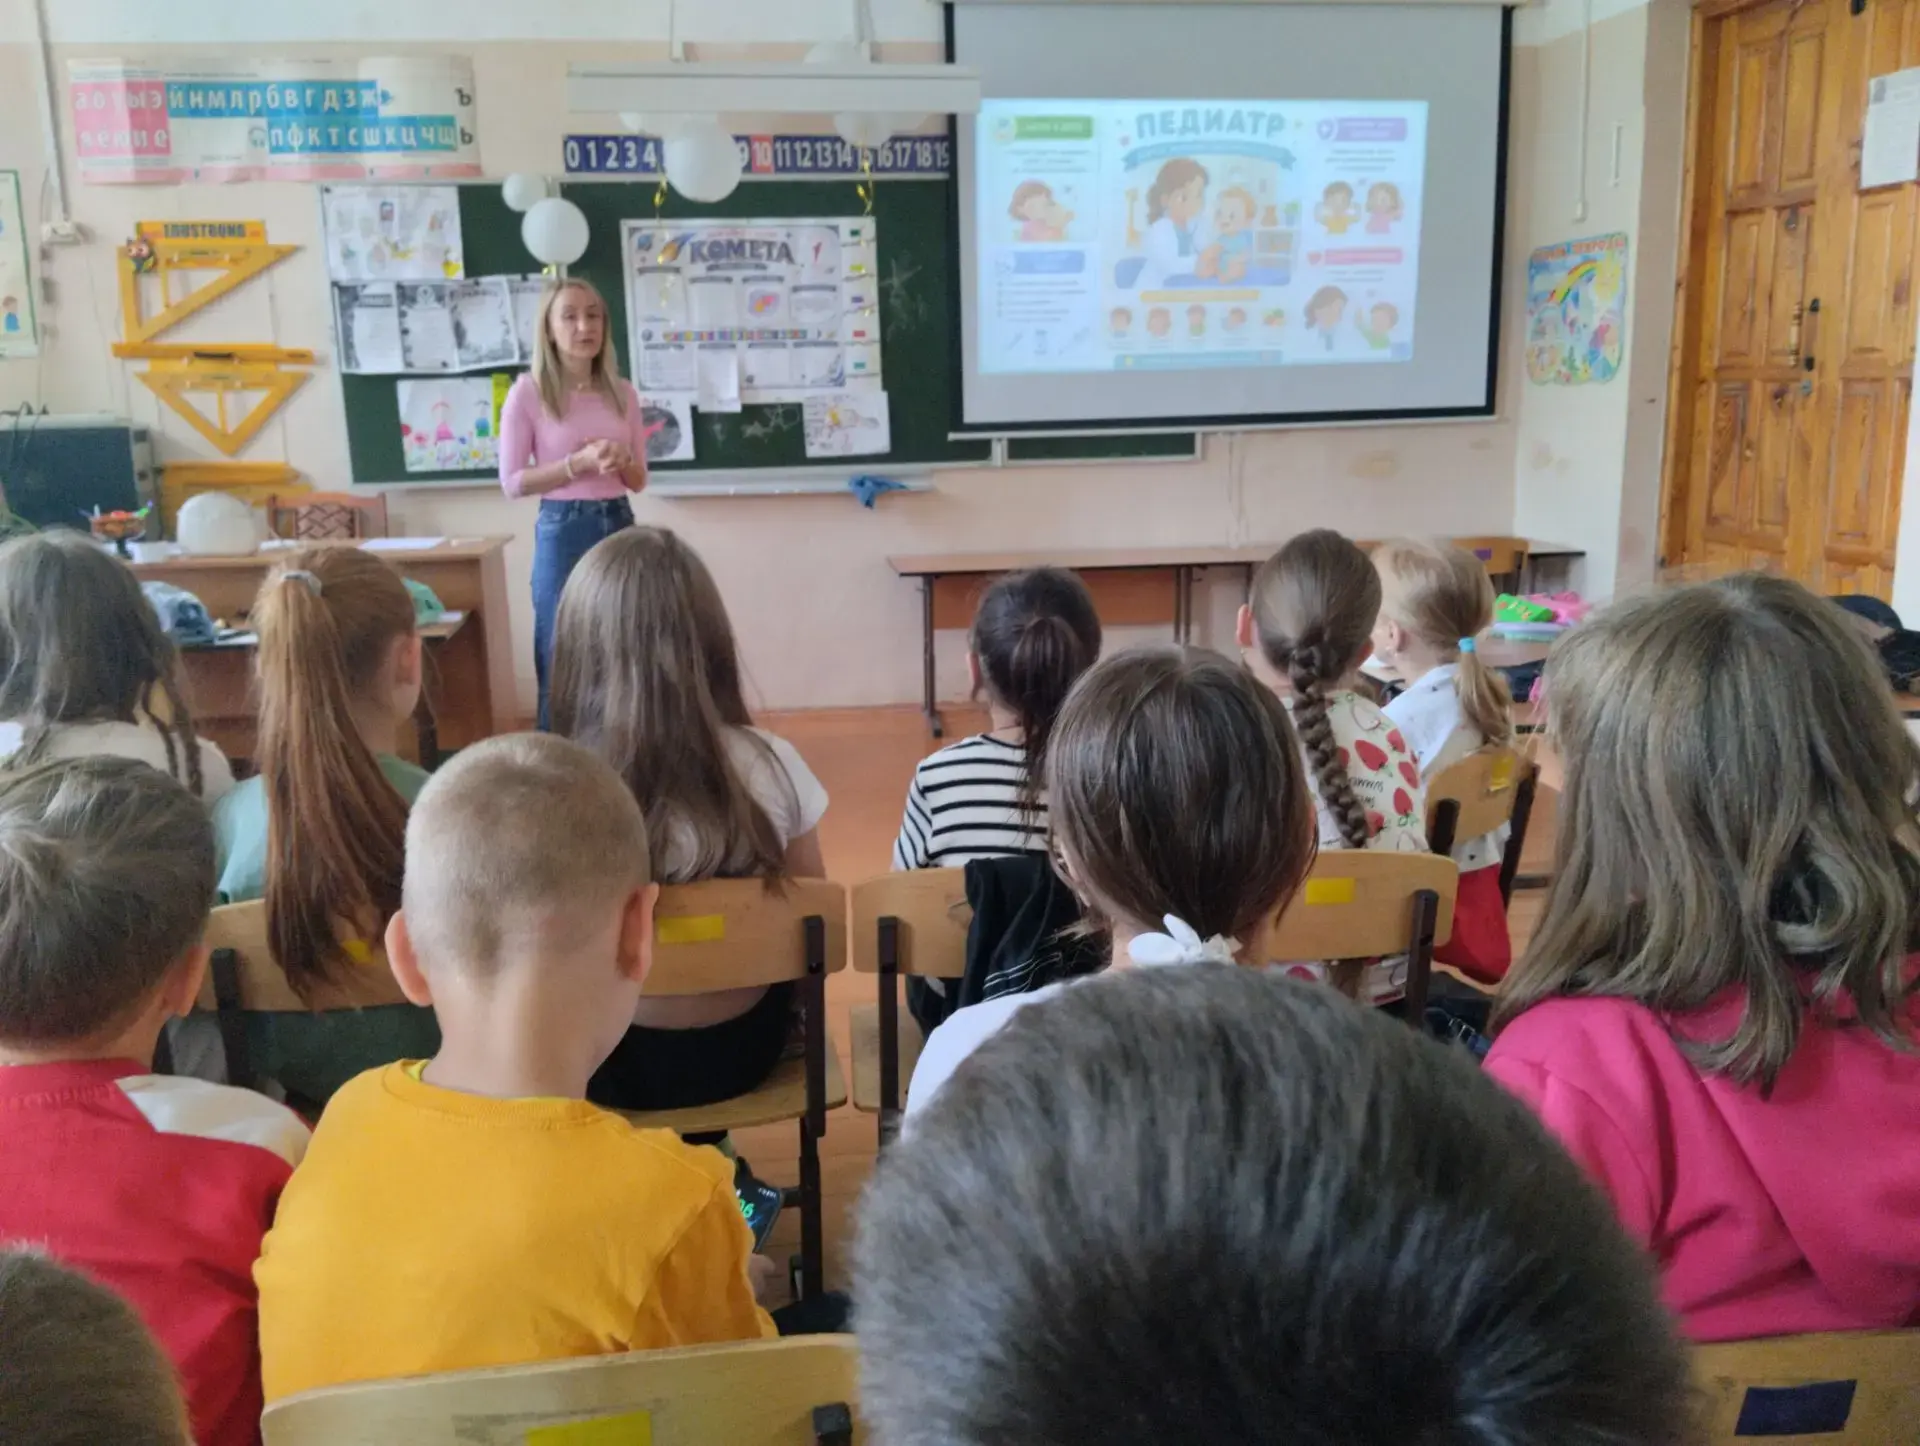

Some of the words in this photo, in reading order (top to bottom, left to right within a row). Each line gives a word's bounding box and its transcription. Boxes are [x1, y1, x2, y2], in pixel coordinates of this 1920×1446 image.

[1135, 107, 1287, 139] ПЕДИАТР
[566, 140, 580, 168] 0
[586, 141, 598, 168] 1
[605, 141, 620, 169] 2
[624, 141, 638, 168] 3
[643, 141, 657, 169] 4
[753, 141, 772, 167] 10
[775, 141, 791, 167] 11
[794, 141, 812, 167] 12
[815, 141, 832, 167] 13
[835, 141, 852, 167] 14
[878, 143, 894, 168] 16
[894, 141, 912, 168] 17
[914, 141, 932, 168] 18
[689, 239, 796, 265] КОМЕТА
